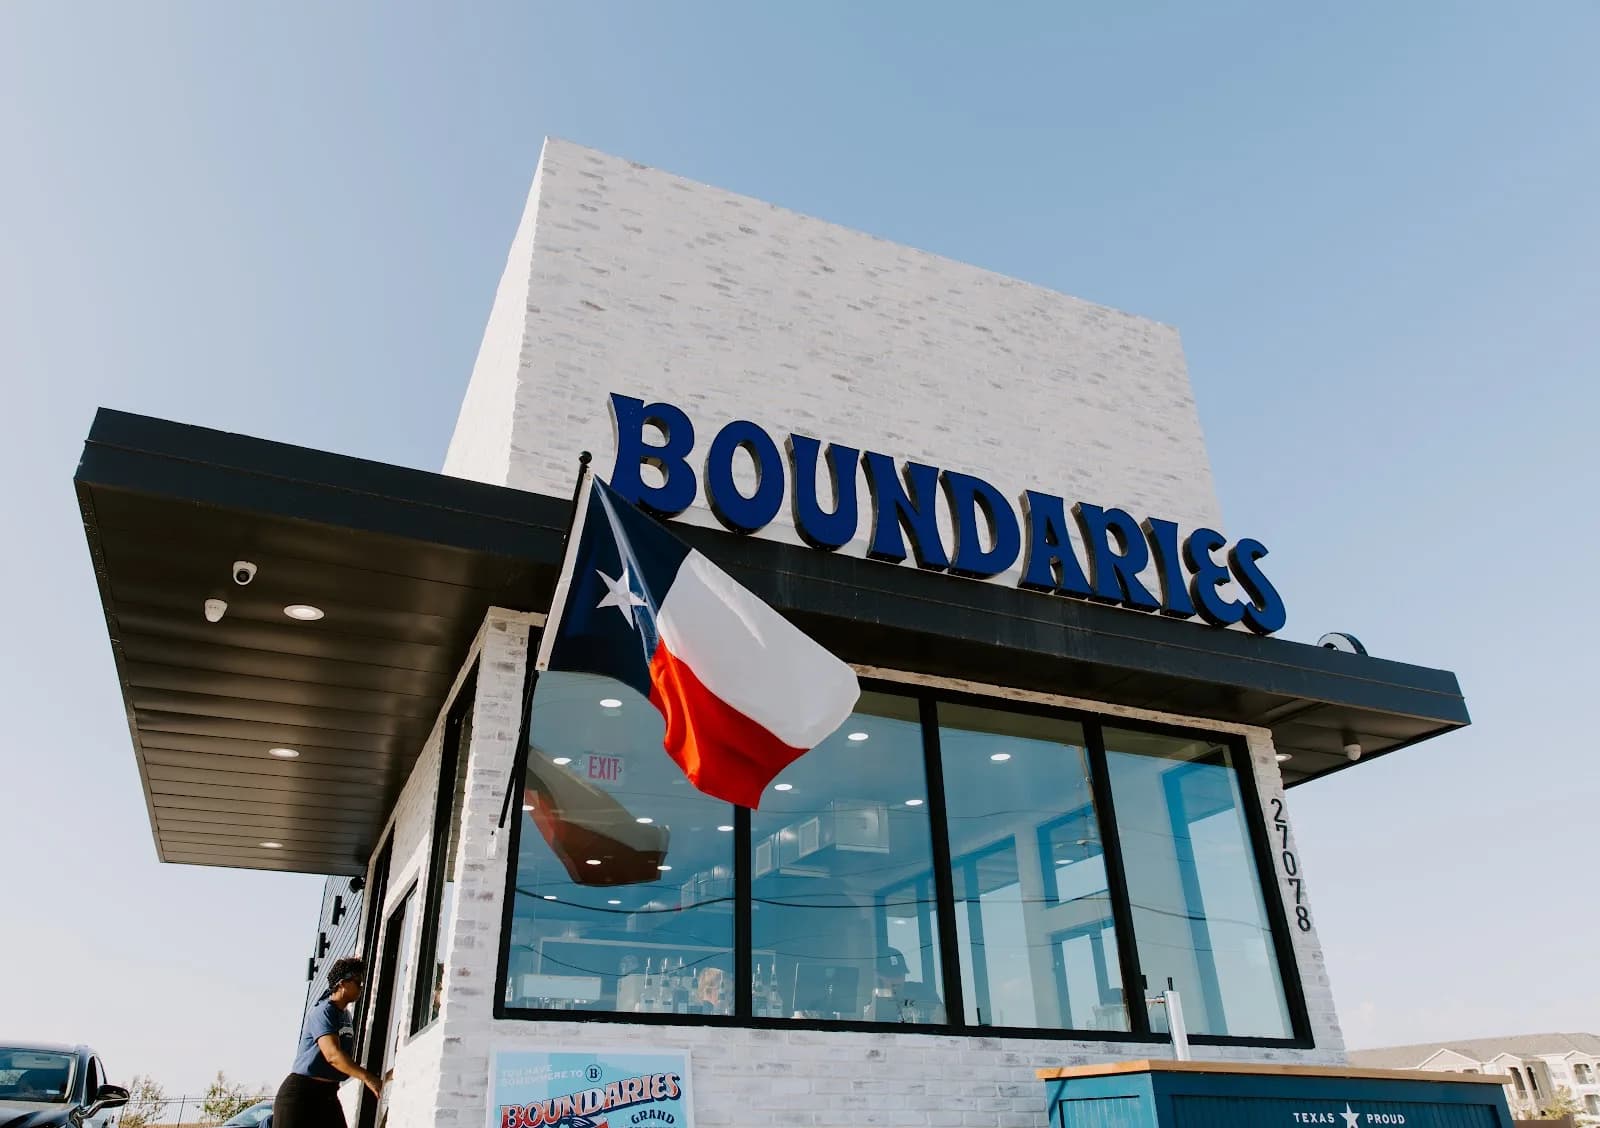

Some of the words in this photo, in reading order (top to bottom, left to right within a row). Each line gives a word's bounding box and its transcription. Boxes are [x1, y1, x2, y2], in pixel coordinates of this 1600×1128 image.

[609, 392, 1287, 636] BOUNDARIES
[588, 755, 620, 781] EXIT
[1271, 798, 1311, 932] 27078
[570, 1070, 584, 1079] TO
[500, 1072, 681, 1128] BOUNDARIES
[631, 1109, 675, 1124] GRAND
[1293, 1112, 1335, 1124] TEXAS
[1366, 1113, 1406, 1124] PROUD
